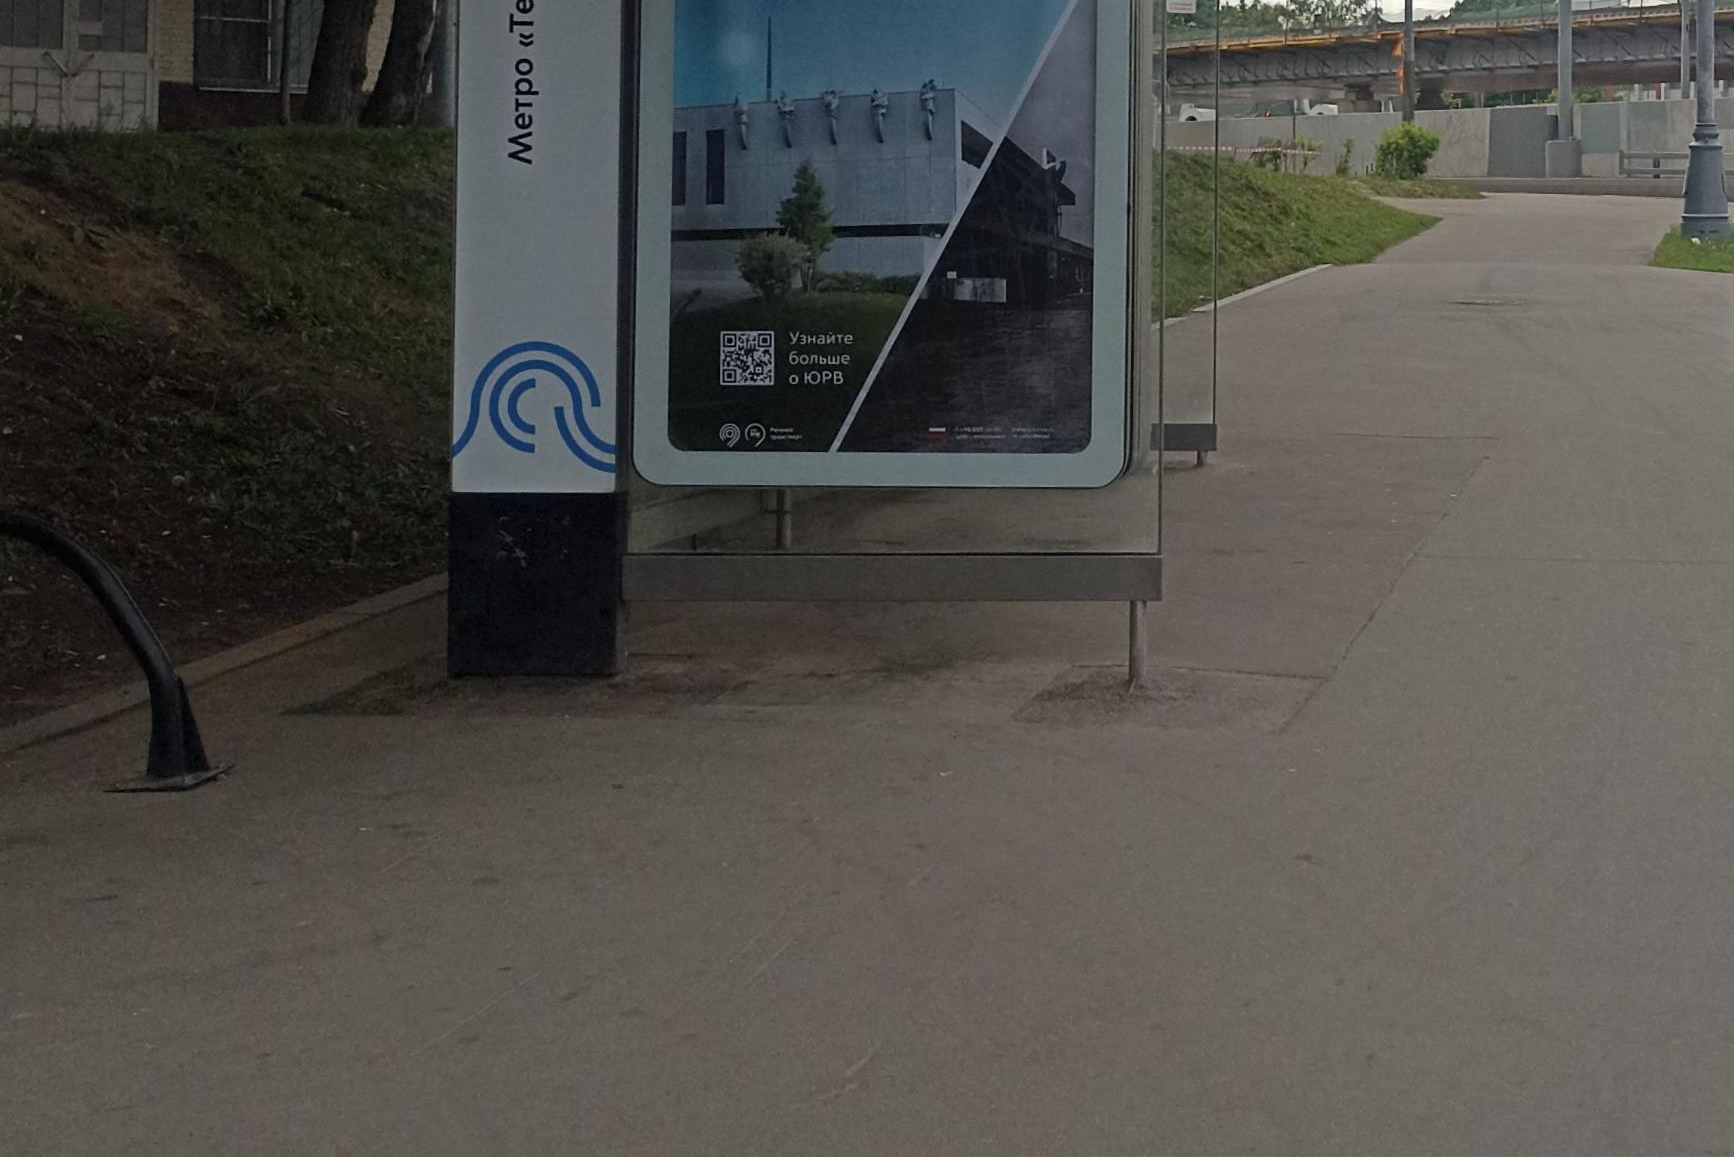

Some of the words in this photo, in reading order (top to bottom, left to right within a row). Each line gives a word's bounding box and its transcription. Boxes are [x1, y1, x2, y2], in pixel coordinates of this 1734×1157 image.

[507, 57, 539, 165] Метро
[789, 330, 854, 345] Узнайте
[788, 350, 851, 365] больше
[788, 374, 799, 385] о
[804, 370, 844, 385] ЮРВ
